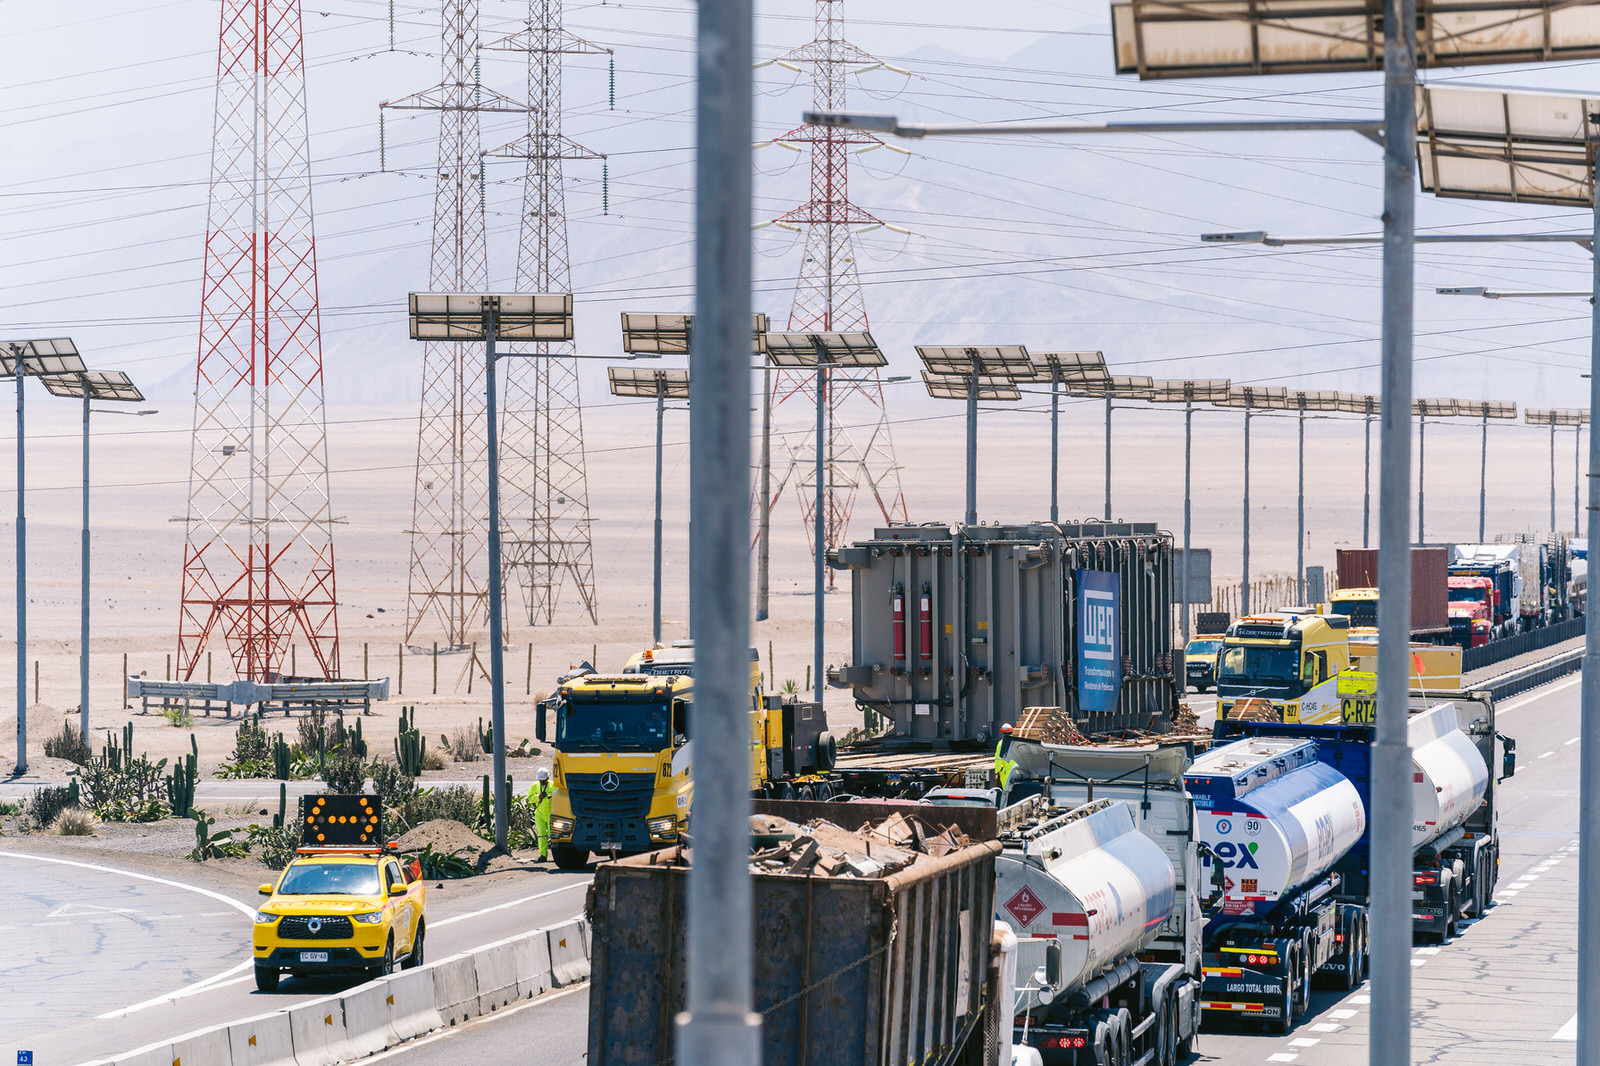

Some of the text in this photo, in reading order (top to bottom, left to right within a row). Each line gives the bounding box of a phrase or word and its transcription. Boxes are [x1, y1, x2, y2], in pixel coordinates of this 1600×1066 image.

[1287, 705, 1297, 716] 927
[1247, 821, 1259, 830] 90
[1226, 984, 1244, 992] LARGO
[1245, 984, 1262, 993] TOTAL
